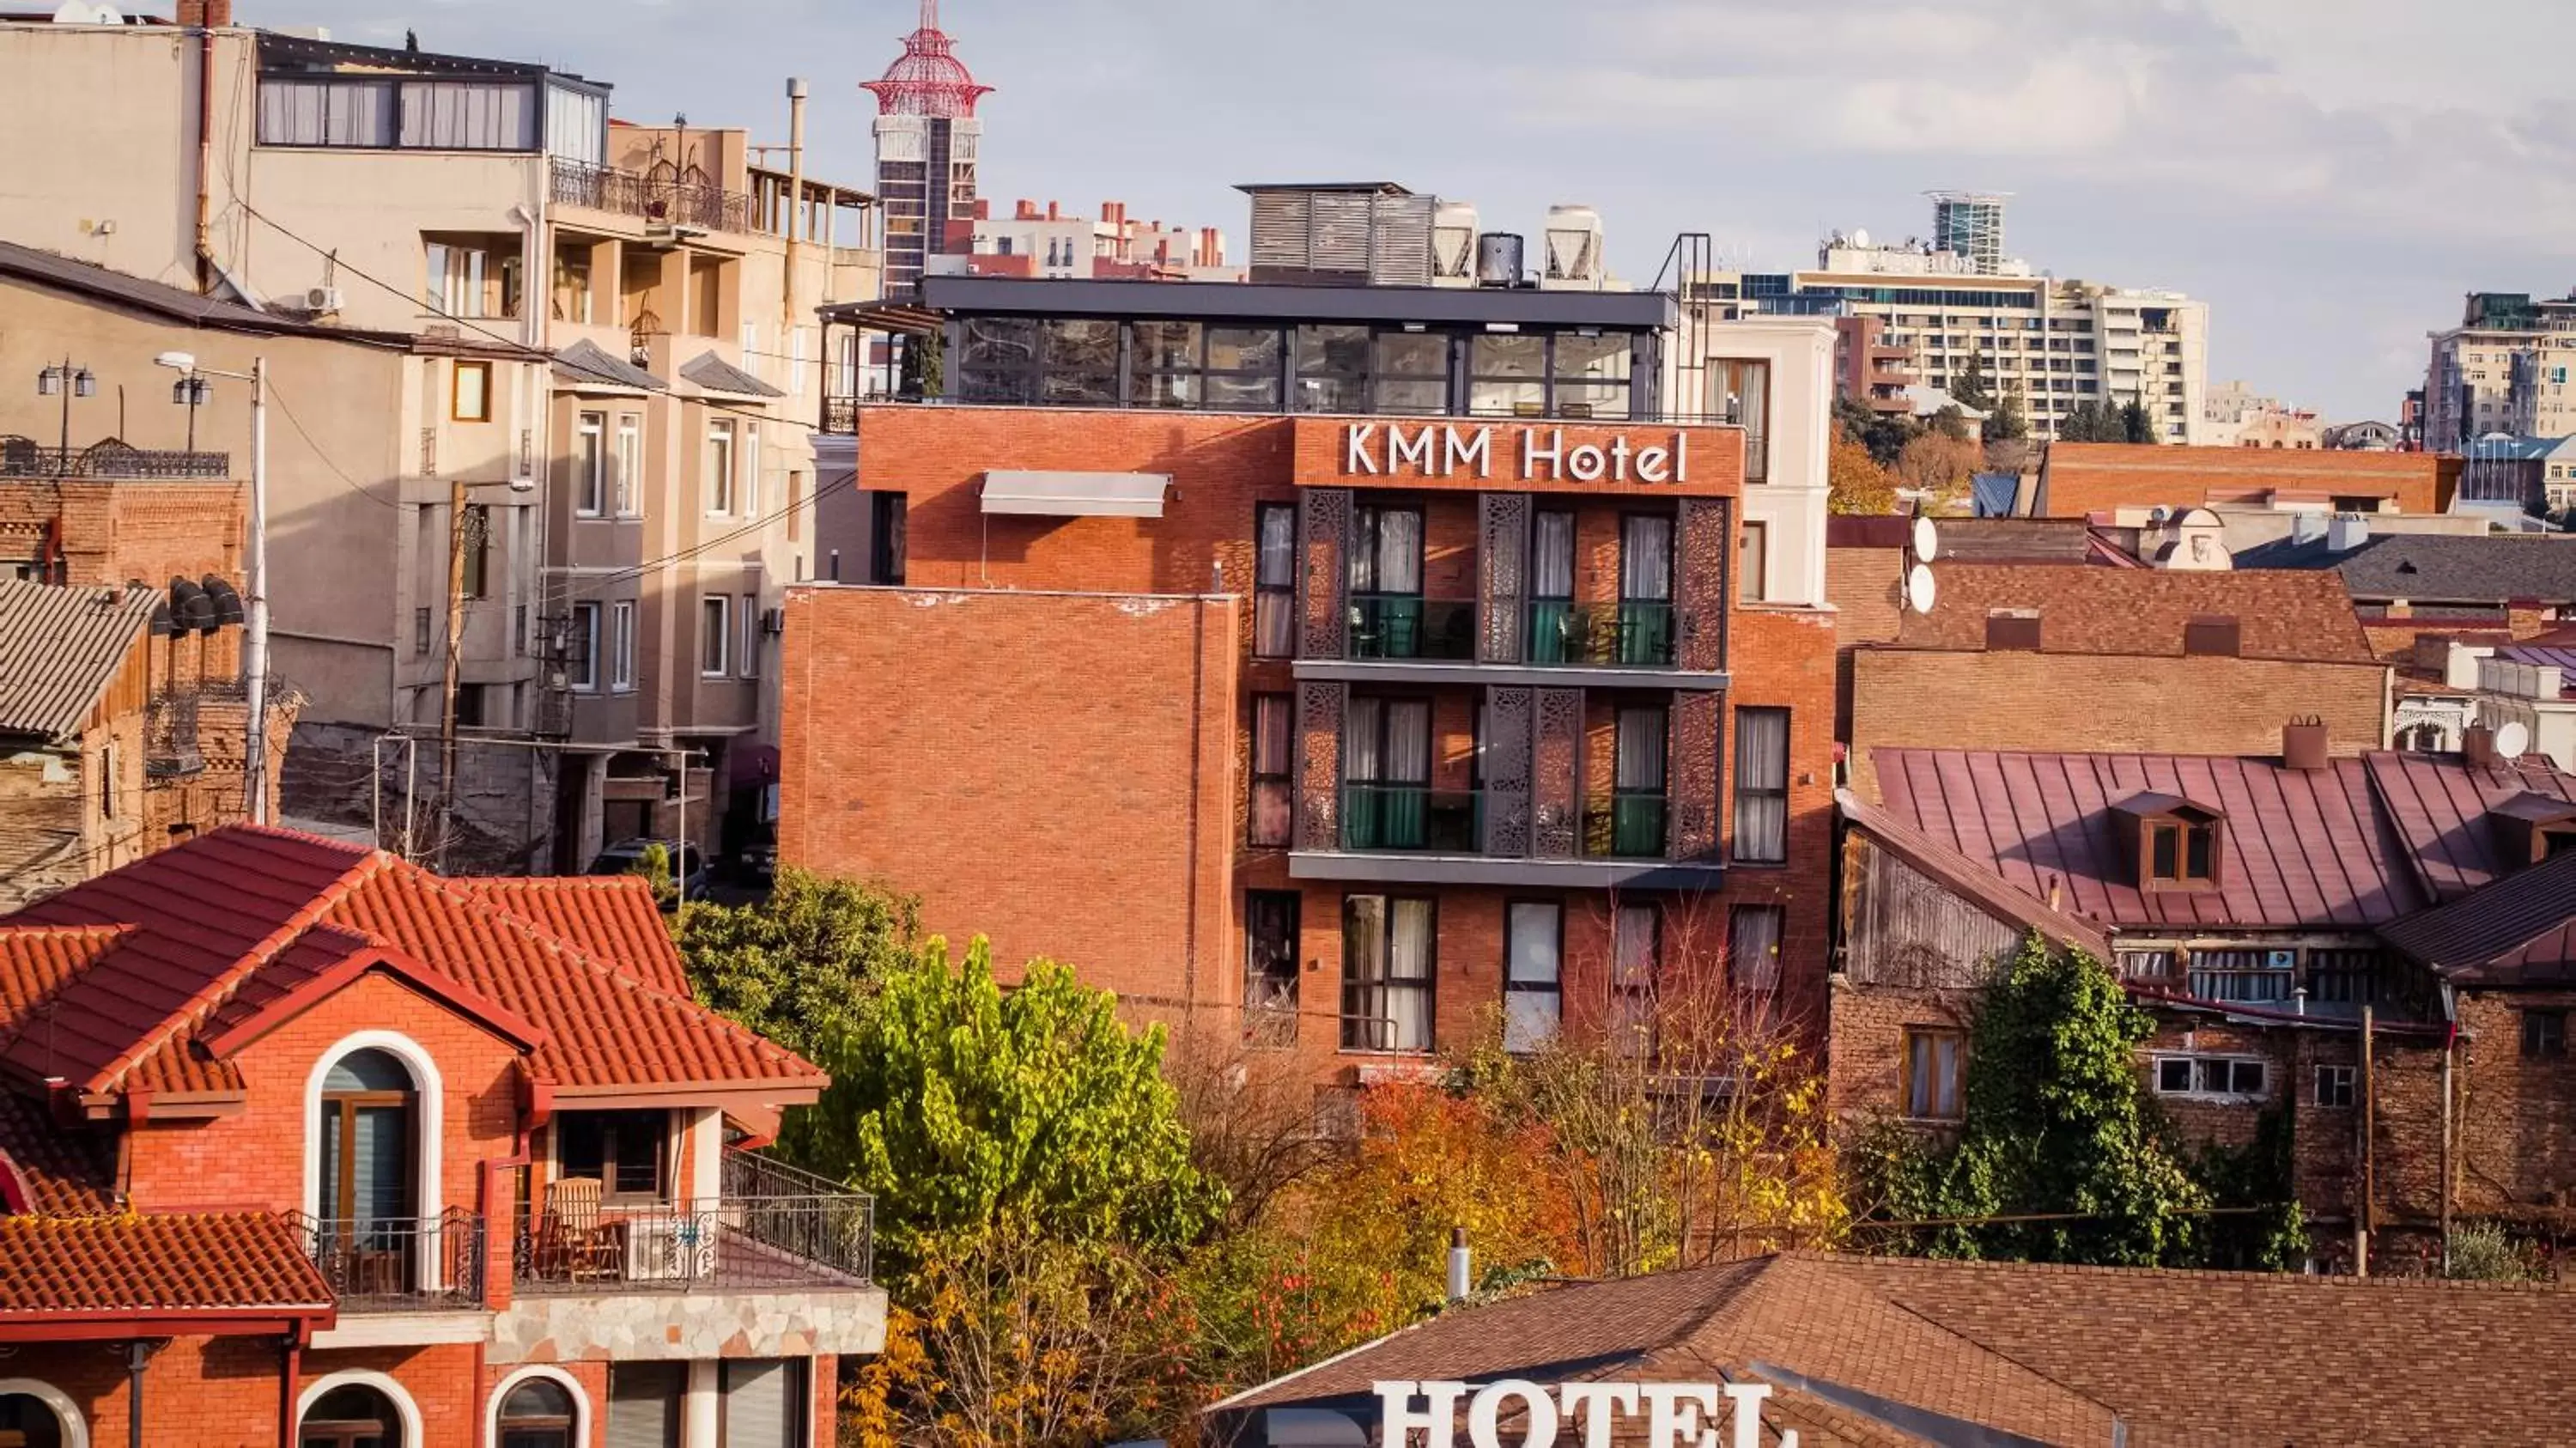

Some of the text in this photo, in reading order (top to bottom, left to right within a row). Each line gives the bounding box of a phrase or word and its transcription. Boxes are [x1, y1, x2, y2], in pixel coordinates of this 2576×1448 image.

[1348, 423, 1687, 482] KMM Hotel
[1372, 1378, 1800, 1448] HOTEL
